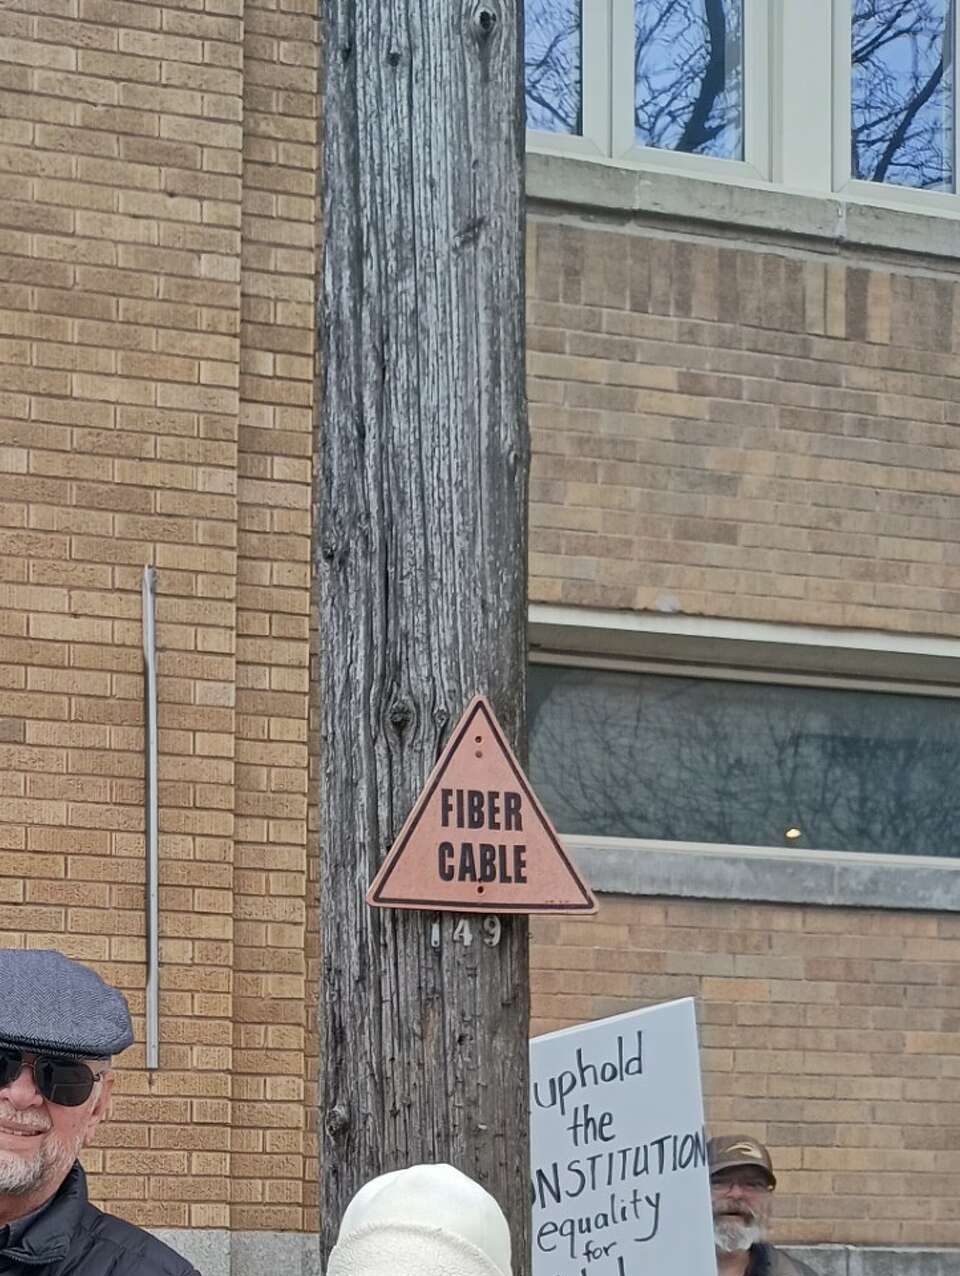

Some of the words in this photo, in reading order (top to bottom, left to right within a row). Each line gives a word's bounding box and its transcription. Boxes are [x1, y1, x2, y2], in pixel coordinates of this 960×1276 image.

[440, 788, 523, 832] FIBER
[437, 841, 528, 884] CABLE
[533, 1030, 643, 1115] uphold
[567, 1104, 616, 1146] the
[529, 1125, 707, 1208] NSTITUTION
[536, 1189, 661, 1259] equality
[583, 1240, 617, 1265] for
